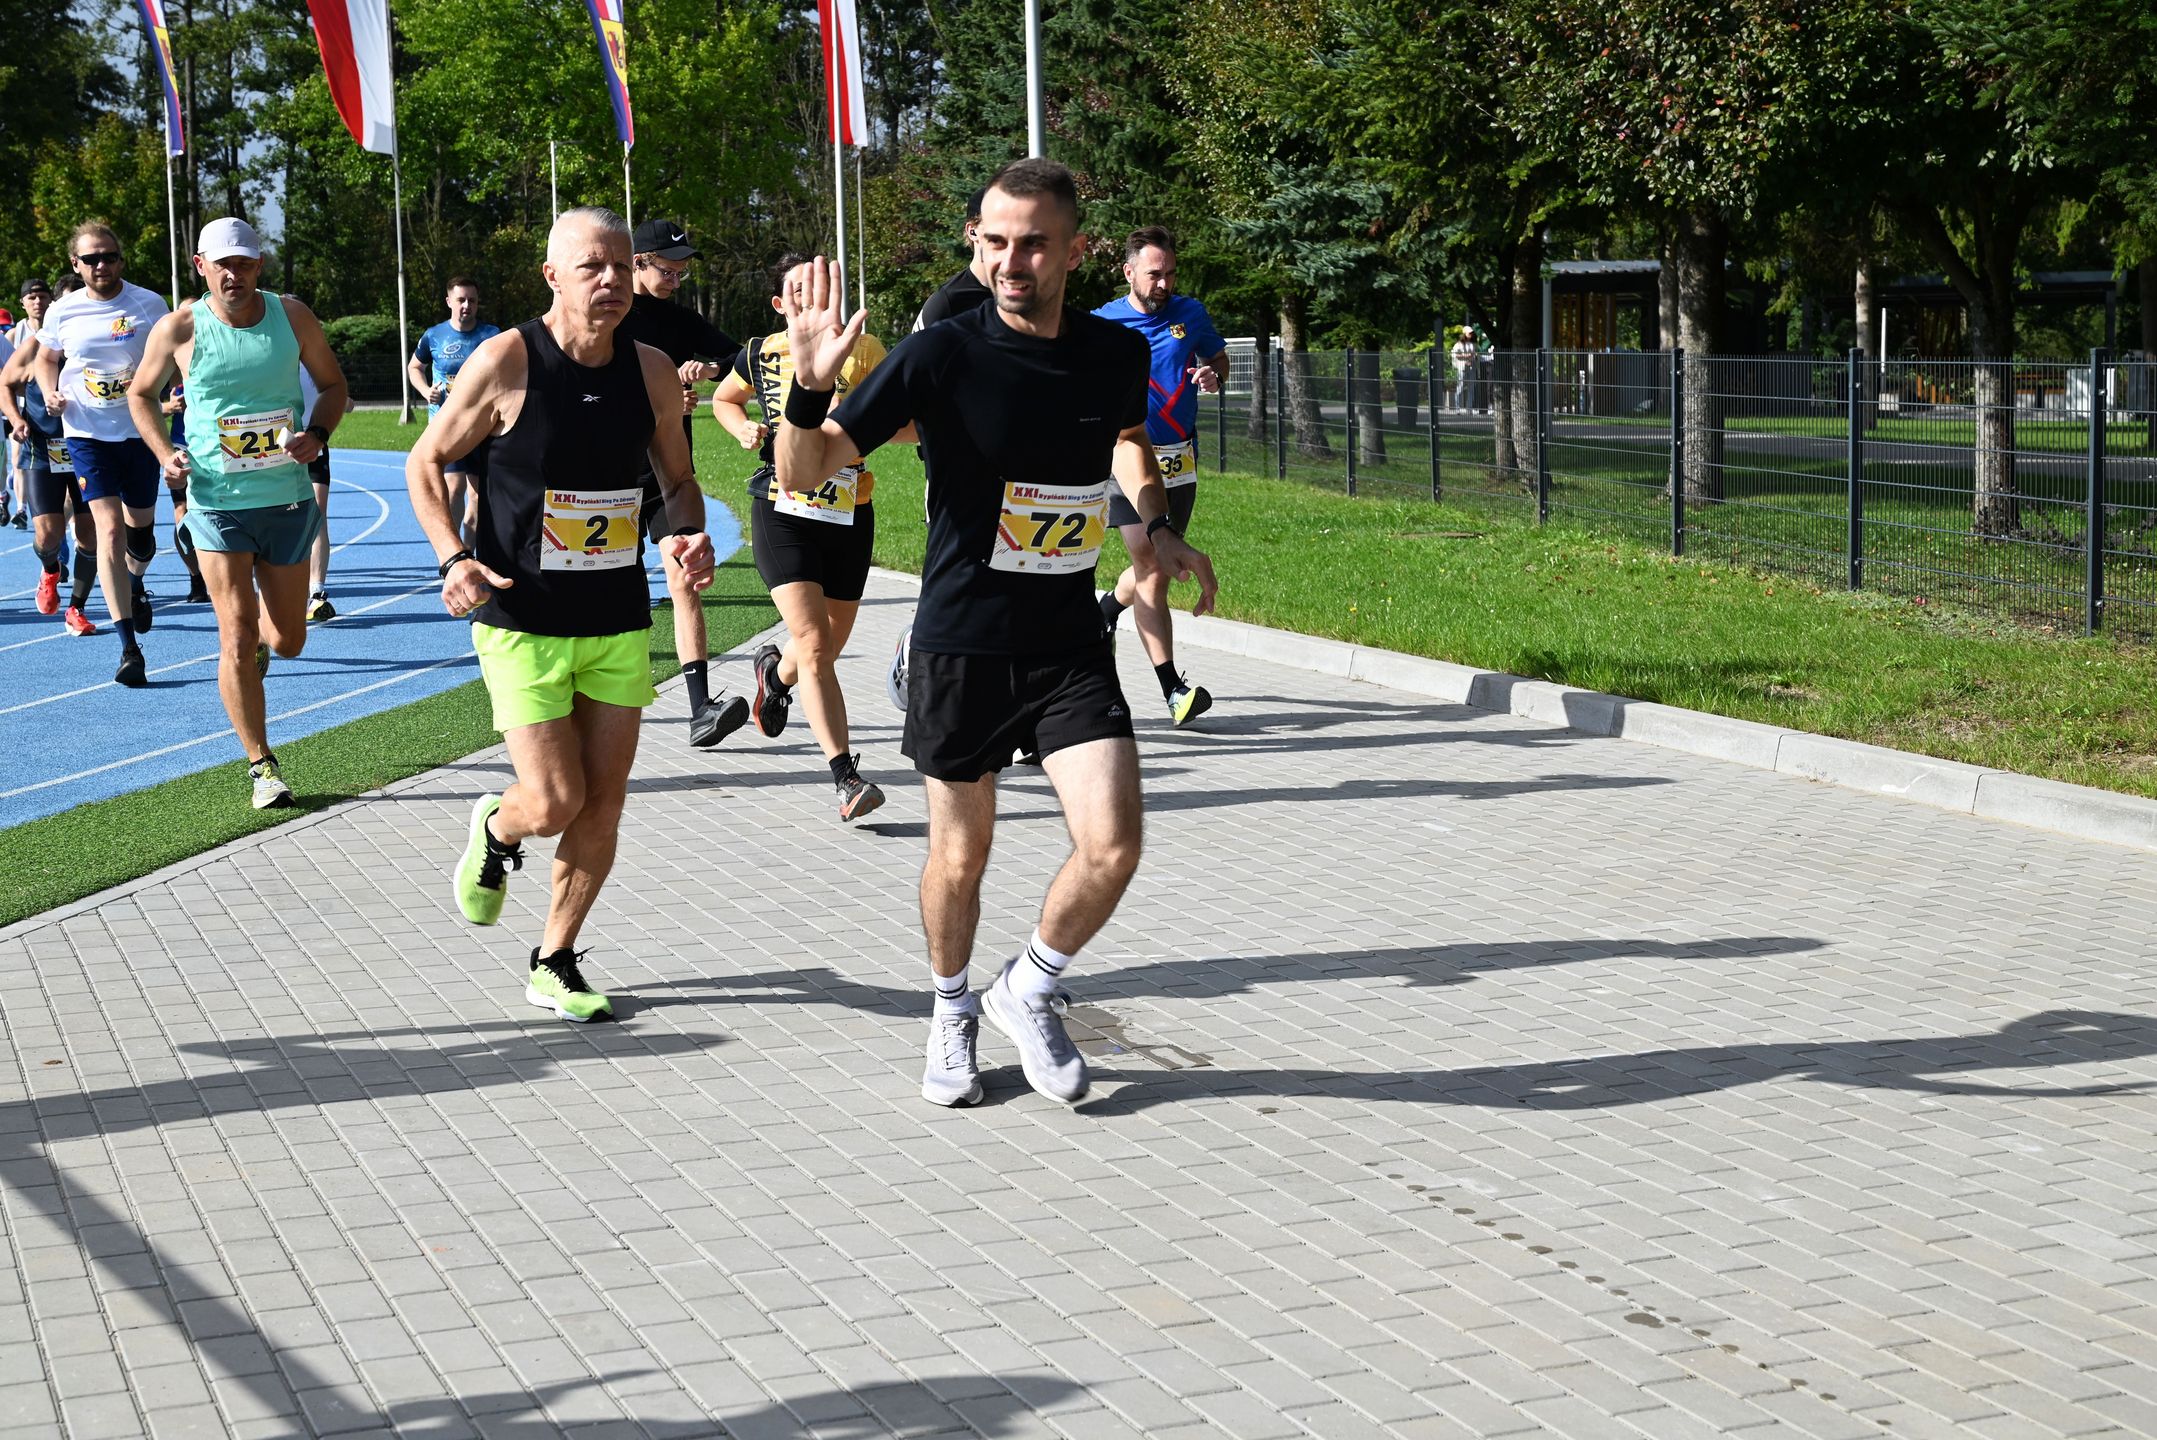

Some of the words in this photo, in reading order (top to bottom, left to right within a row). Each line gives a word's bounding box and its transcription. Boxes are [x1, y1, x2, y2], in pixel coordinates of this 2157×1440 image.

[97, 379, 125, 396] 34
[223, 418, 239, 426] XXI
[240, 428, 279, 455] 21
[1160, 453, 1183, 475] 35
[553, 493, 577, 503] XXI
[1013, 487, 1039, 498] XXI
[584, 515, 609, 547] 2
[1030, 512, 1087, 548] 72
